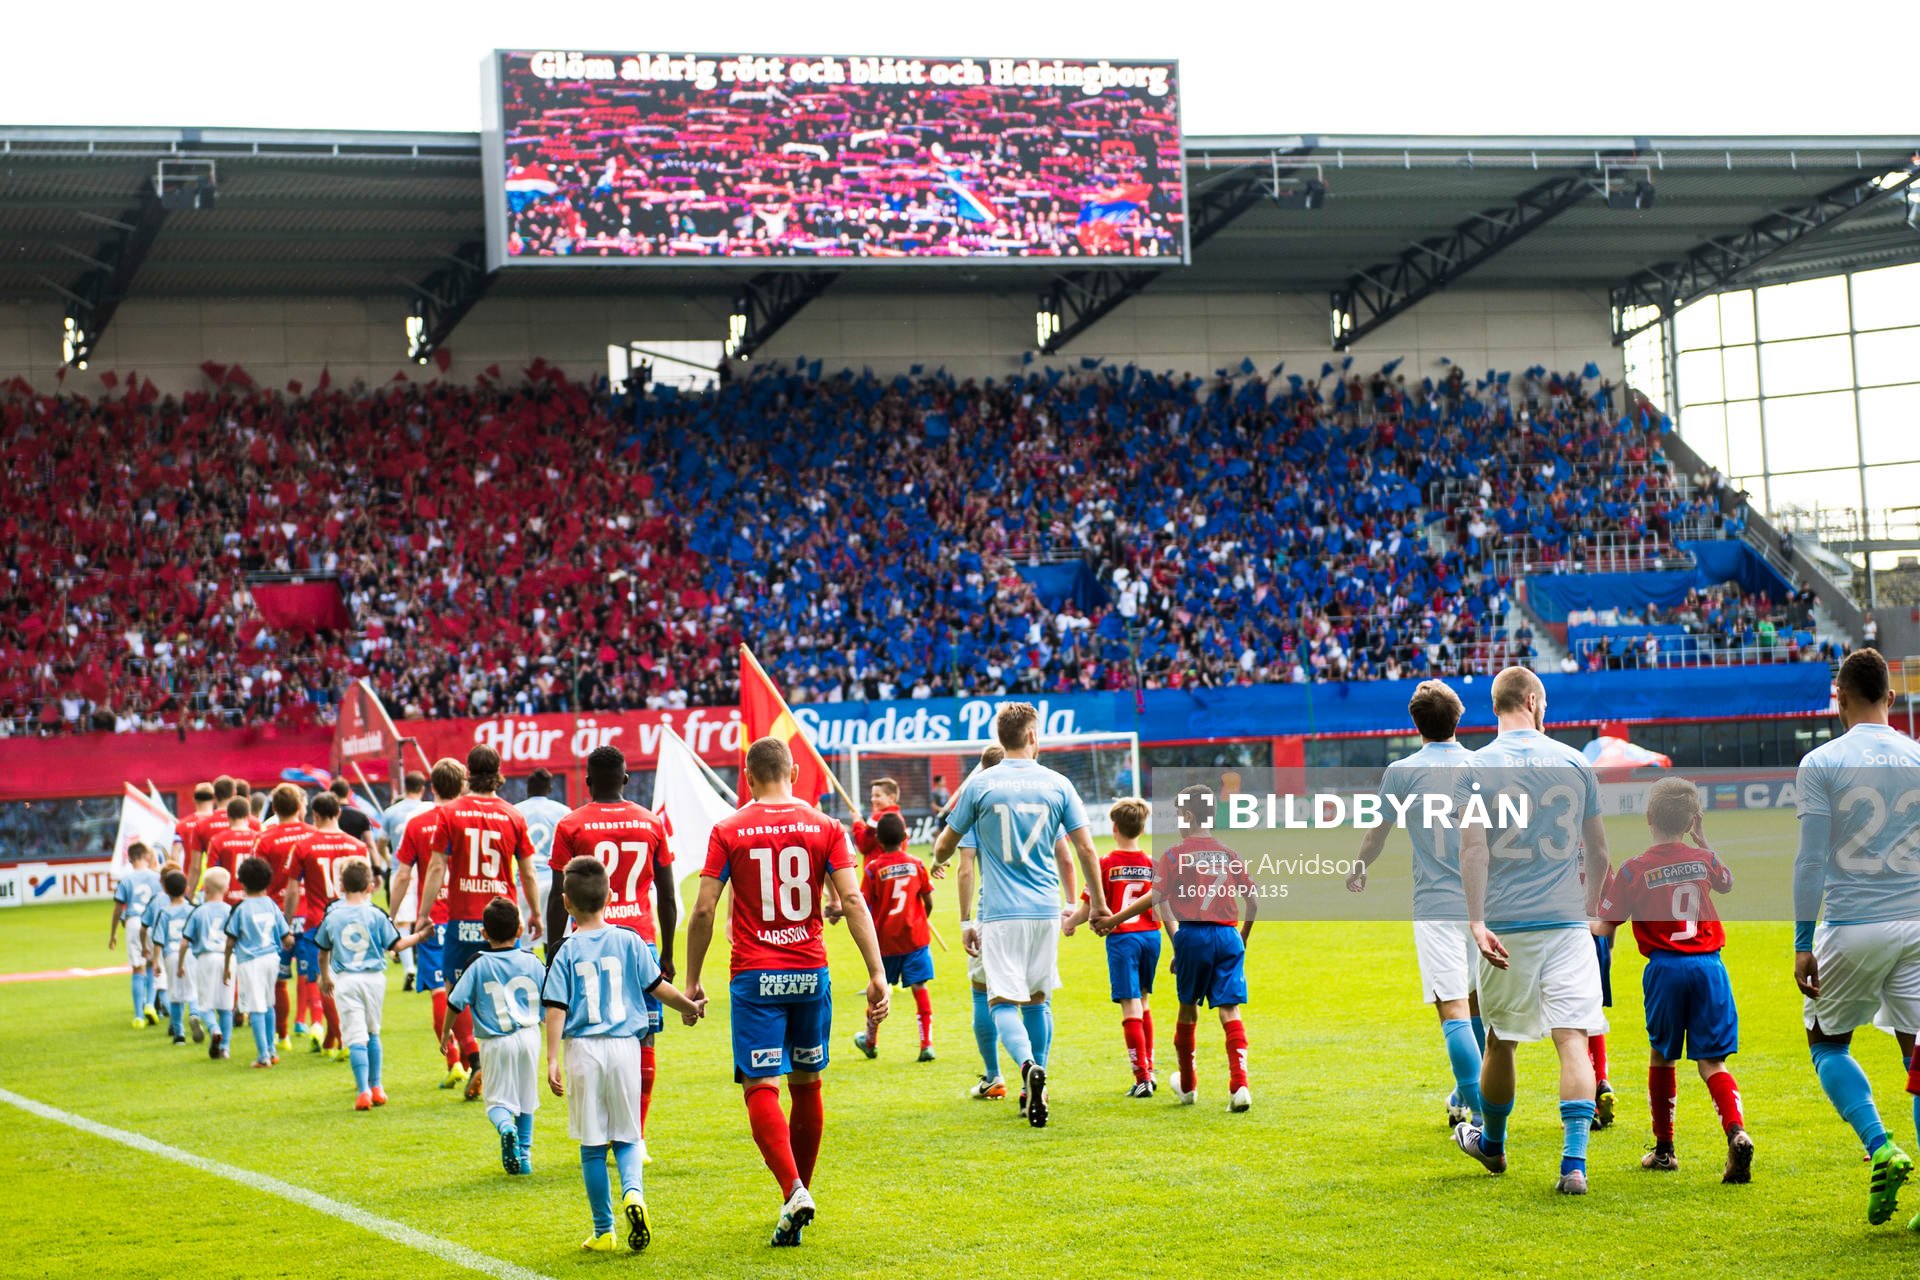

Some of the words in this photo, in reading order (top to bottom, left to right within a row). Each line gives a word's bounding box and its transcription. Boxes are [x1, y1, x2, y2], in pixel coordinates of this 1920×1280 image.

[530, 51, 616, 80] Glöm
[620, 53, 717, 90] aldrig
[719, 55, 785, 82] rött
[789, 56, 846, 83] och
[930, 58, 984, 85] och
[988, 58, 1169, 96] Helsingborg
[474, 719, 564, 761] Här
[571, 717, 624, 758] är
[683, 709, 743, 753] frå
[792, 706, 951, 749] Sundets
[737, 822, 821, 837] NORDSTRÖMS
[992, 803, 1050, 863] 17
[1491, 785, 1579, 860] 23
[1835, 786, 1920, 875] 22
[464, 827, 501, 878] 15
[594, 840, 648, 902] 27
[749, 846, 812, 921] 18
[888, 877, 910, 916] 5
[1200, 869, 1228, 911] 7
[252, 912, 275, 948] 7
[757, 926, 809, 945] LARSSON
[1670, 883, 1700, 941] 9
[341, 922, 369, 967] 9
[574, 956, 627, 1024] 11
[759, 972, 818, 984] ÖRESUNDS
[760, 982, 818, 996] KRAFT
[483, 976, 540, 1032] 10
